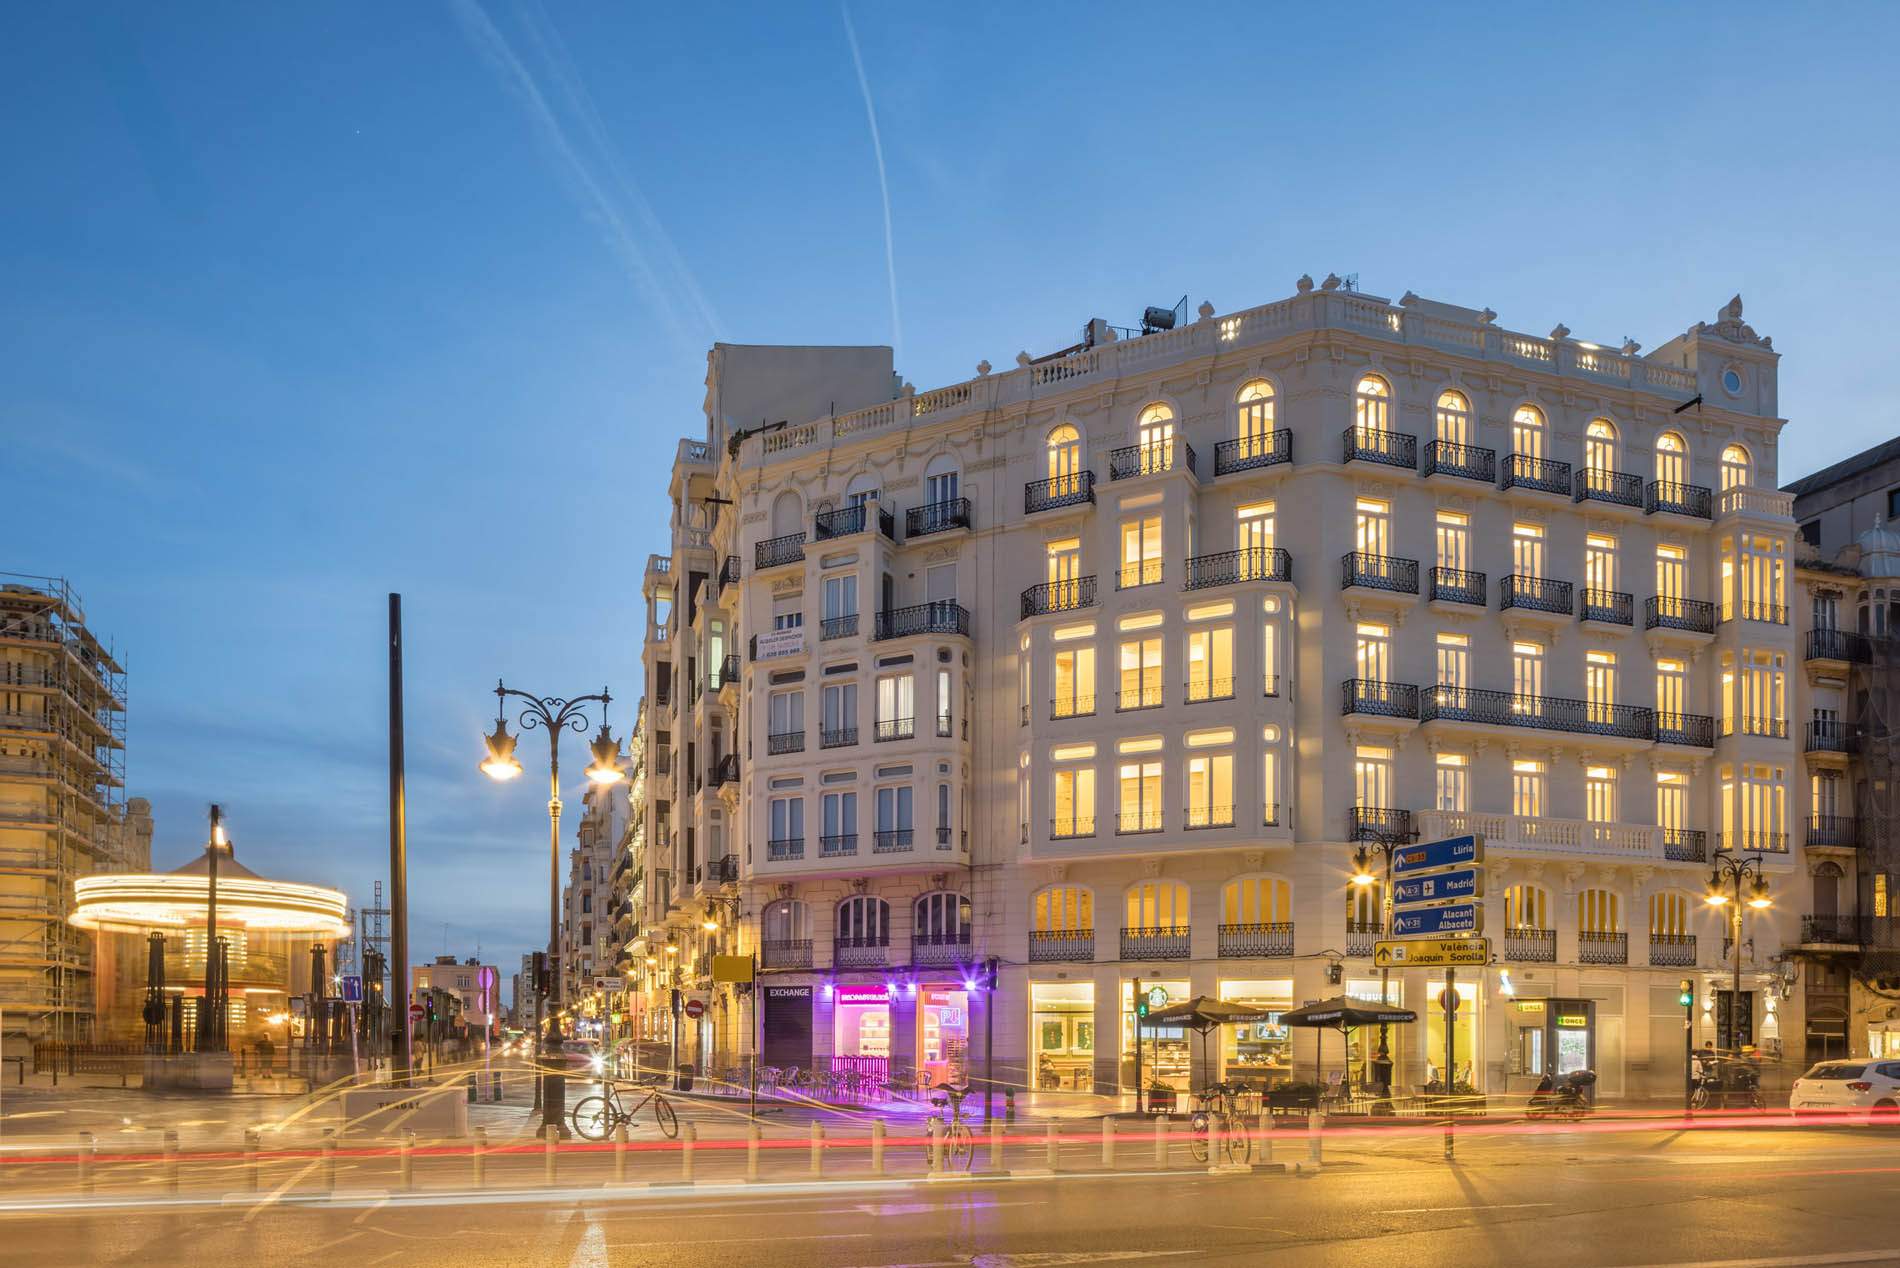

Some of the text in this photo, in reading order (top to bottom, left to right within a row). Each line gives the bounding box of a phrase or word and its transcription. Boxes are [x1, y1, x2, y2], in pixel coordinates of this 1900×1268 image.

[1446, 878, 1474, 890] Madrid
[1443, 909, 1473, 919] Alacant
[1439, 920, 1473, 930] Albacete
[1450, 953, 1484, 961] Sorolla
[769, 988, 810, 997] EXCHANGE
